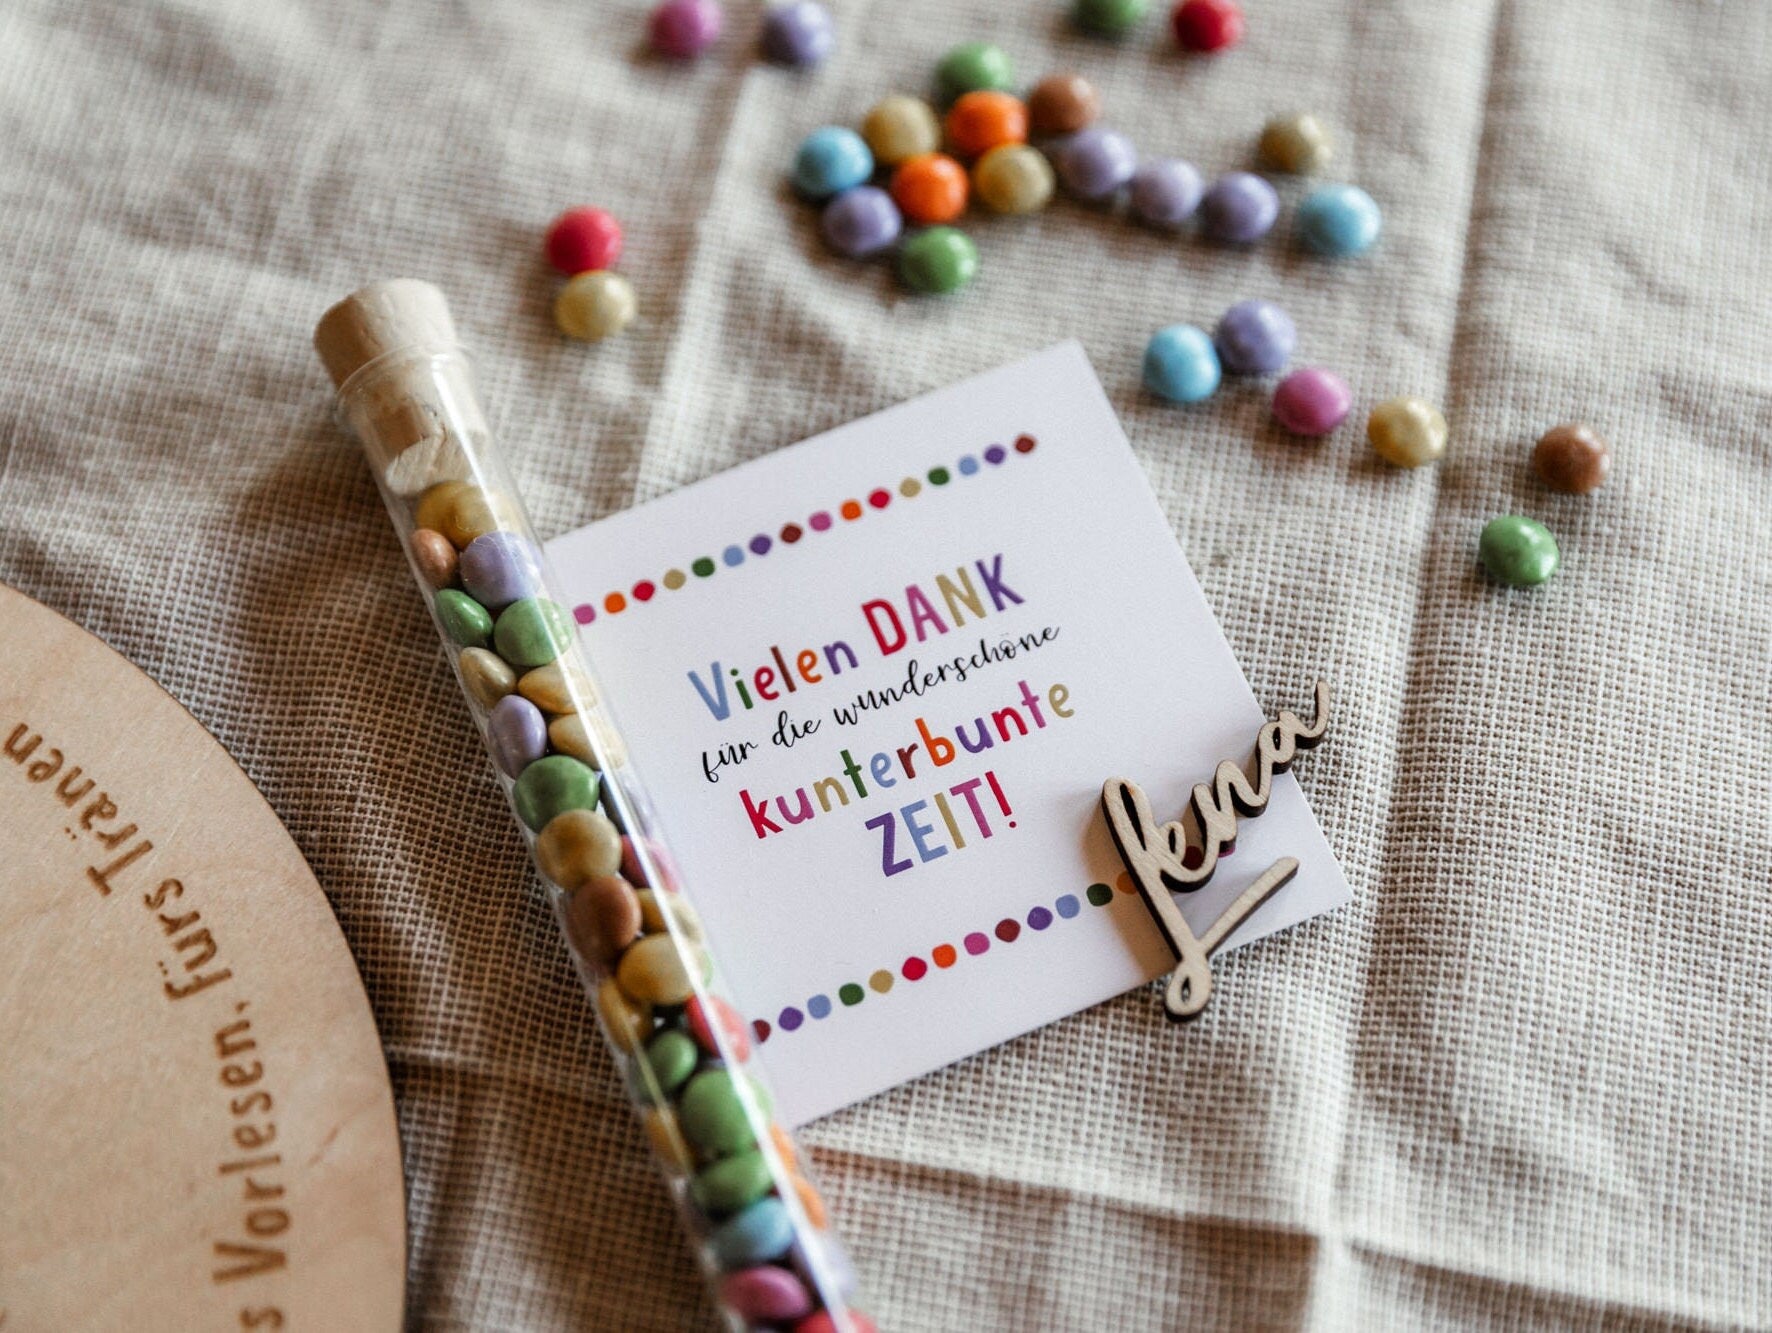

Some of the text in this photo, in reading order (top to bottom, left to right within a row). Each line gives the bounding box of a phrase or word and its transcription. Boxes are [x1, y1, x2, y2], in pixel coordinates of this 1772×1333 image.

[686, 552, 1026, 722] Vielen DANK
[701, 626, 1061, 784] für die wunderschöne
[2, 722, 155, 898] Tränen
[738, 680, 1075, 840] kunterbunte
[864, 770, 1018, 878] ZEIT!
[212, 1001, 291, 1284] Vorlesen,
